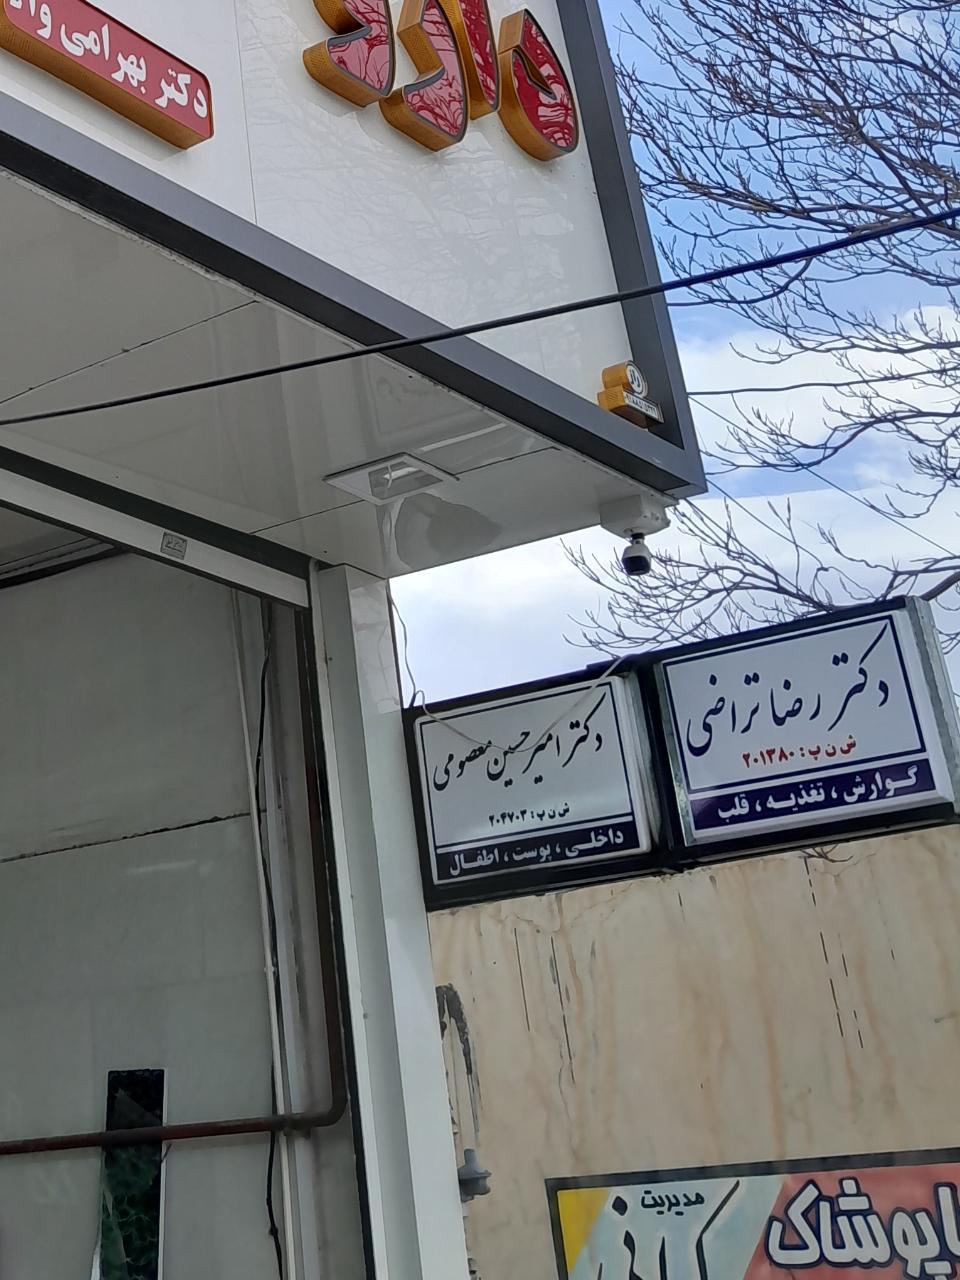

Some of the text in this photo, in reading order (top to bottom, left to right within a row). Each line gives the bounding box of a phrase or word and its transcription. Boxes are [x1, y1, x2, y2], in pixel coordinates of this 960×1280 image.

[60, 23, 147, 94] بهرامی
[154, 68, 208, 118] دکتر
[687, 622, 889, 757] دکتر رضا تراضی
[562, 691, 607, 767] دکتر
[433, 739, 493, 791] معصومی
[742, 746, 795, 768] ۲۰۱۳۸۰
[717, 794, 749, 820] قلب
[449, 849, 499, 876] اطفال
[640, 1189, 706, 1217] مدیریت
